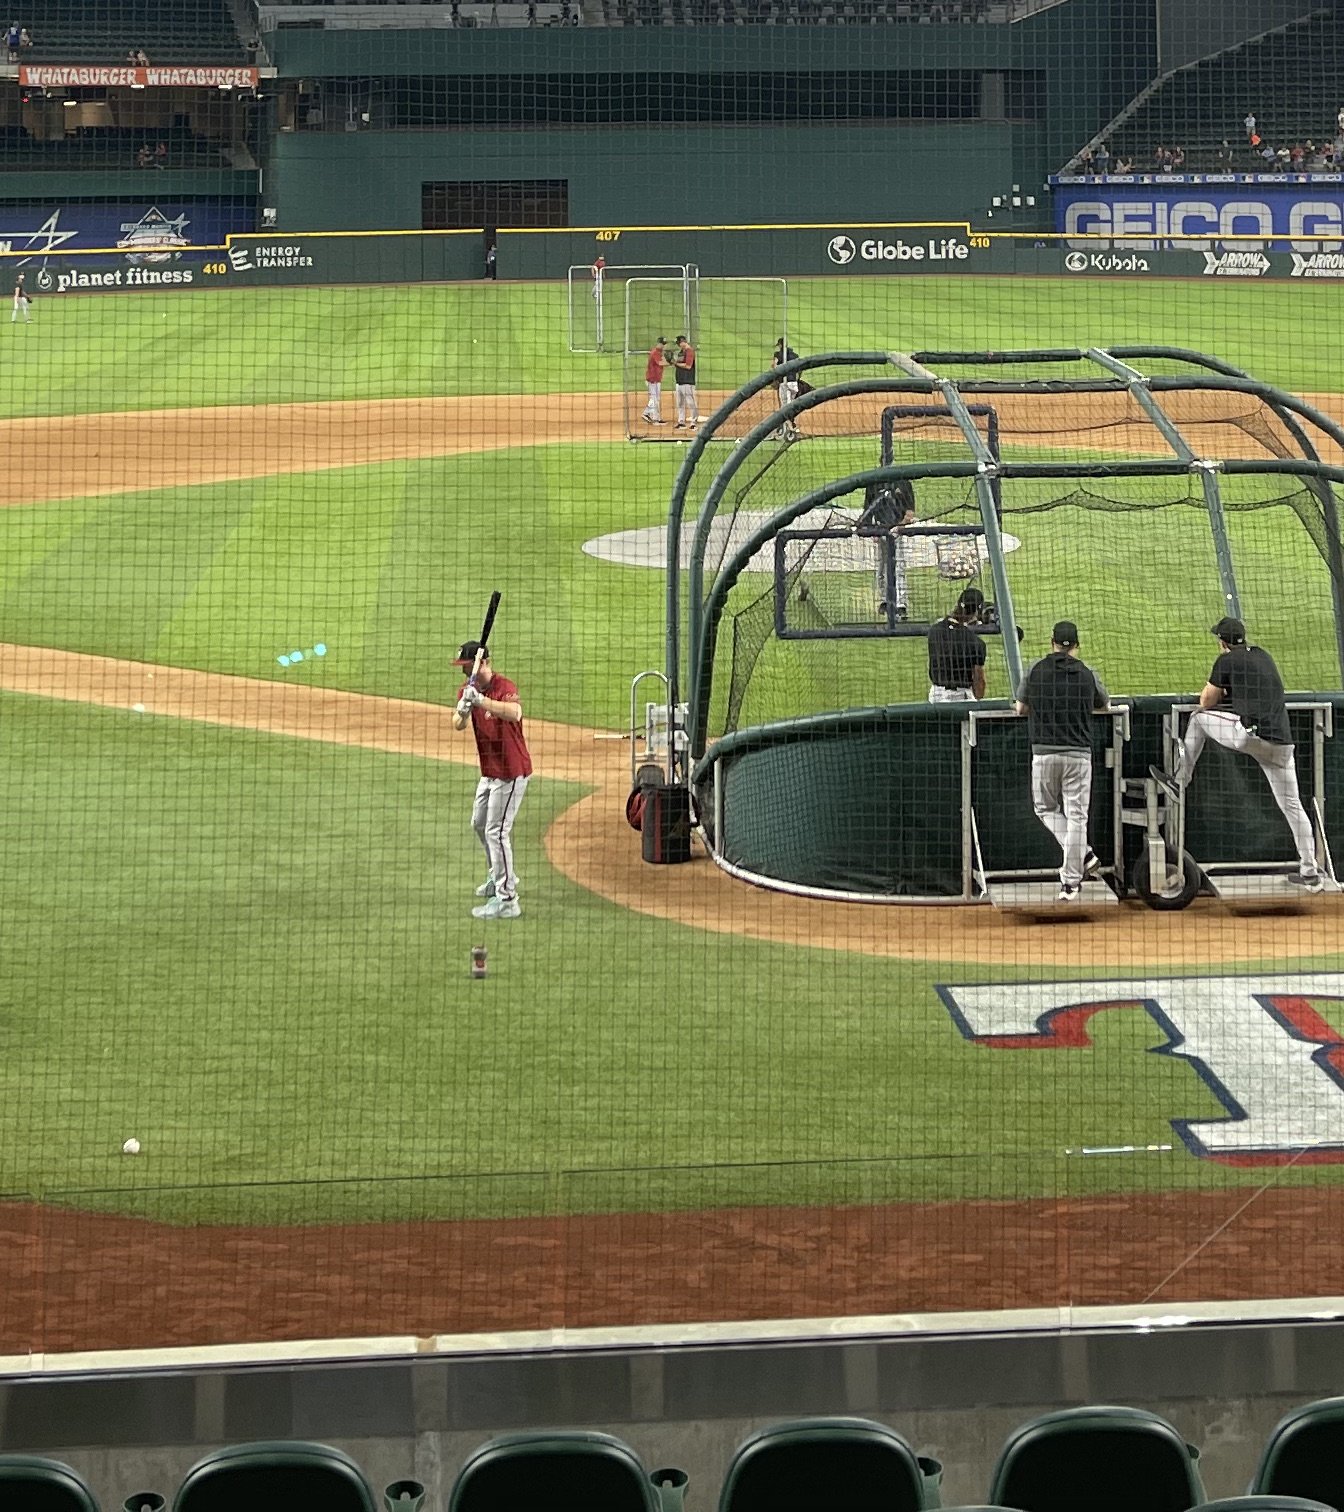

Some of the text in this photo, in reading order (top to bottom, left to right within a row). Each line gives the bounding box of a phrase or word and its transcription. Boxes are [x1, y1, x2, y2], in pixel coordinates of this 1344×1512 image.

[26, 68, 253, 86] WHATABURGER WHATABURGER
[1065, 201, 1273, 251] GEICO
[595, 230, 621, 242] 407
[255, 246, 301, 257] ENERGY
[860, 237, 990, 261] Globe Life 410
[203, 263, 227, 275] 410
[256, 256, 313, 268] TRANSFER
[1090, 253, 1150, 272] Kubota
[57, 268, 193, 292] planet fitness
